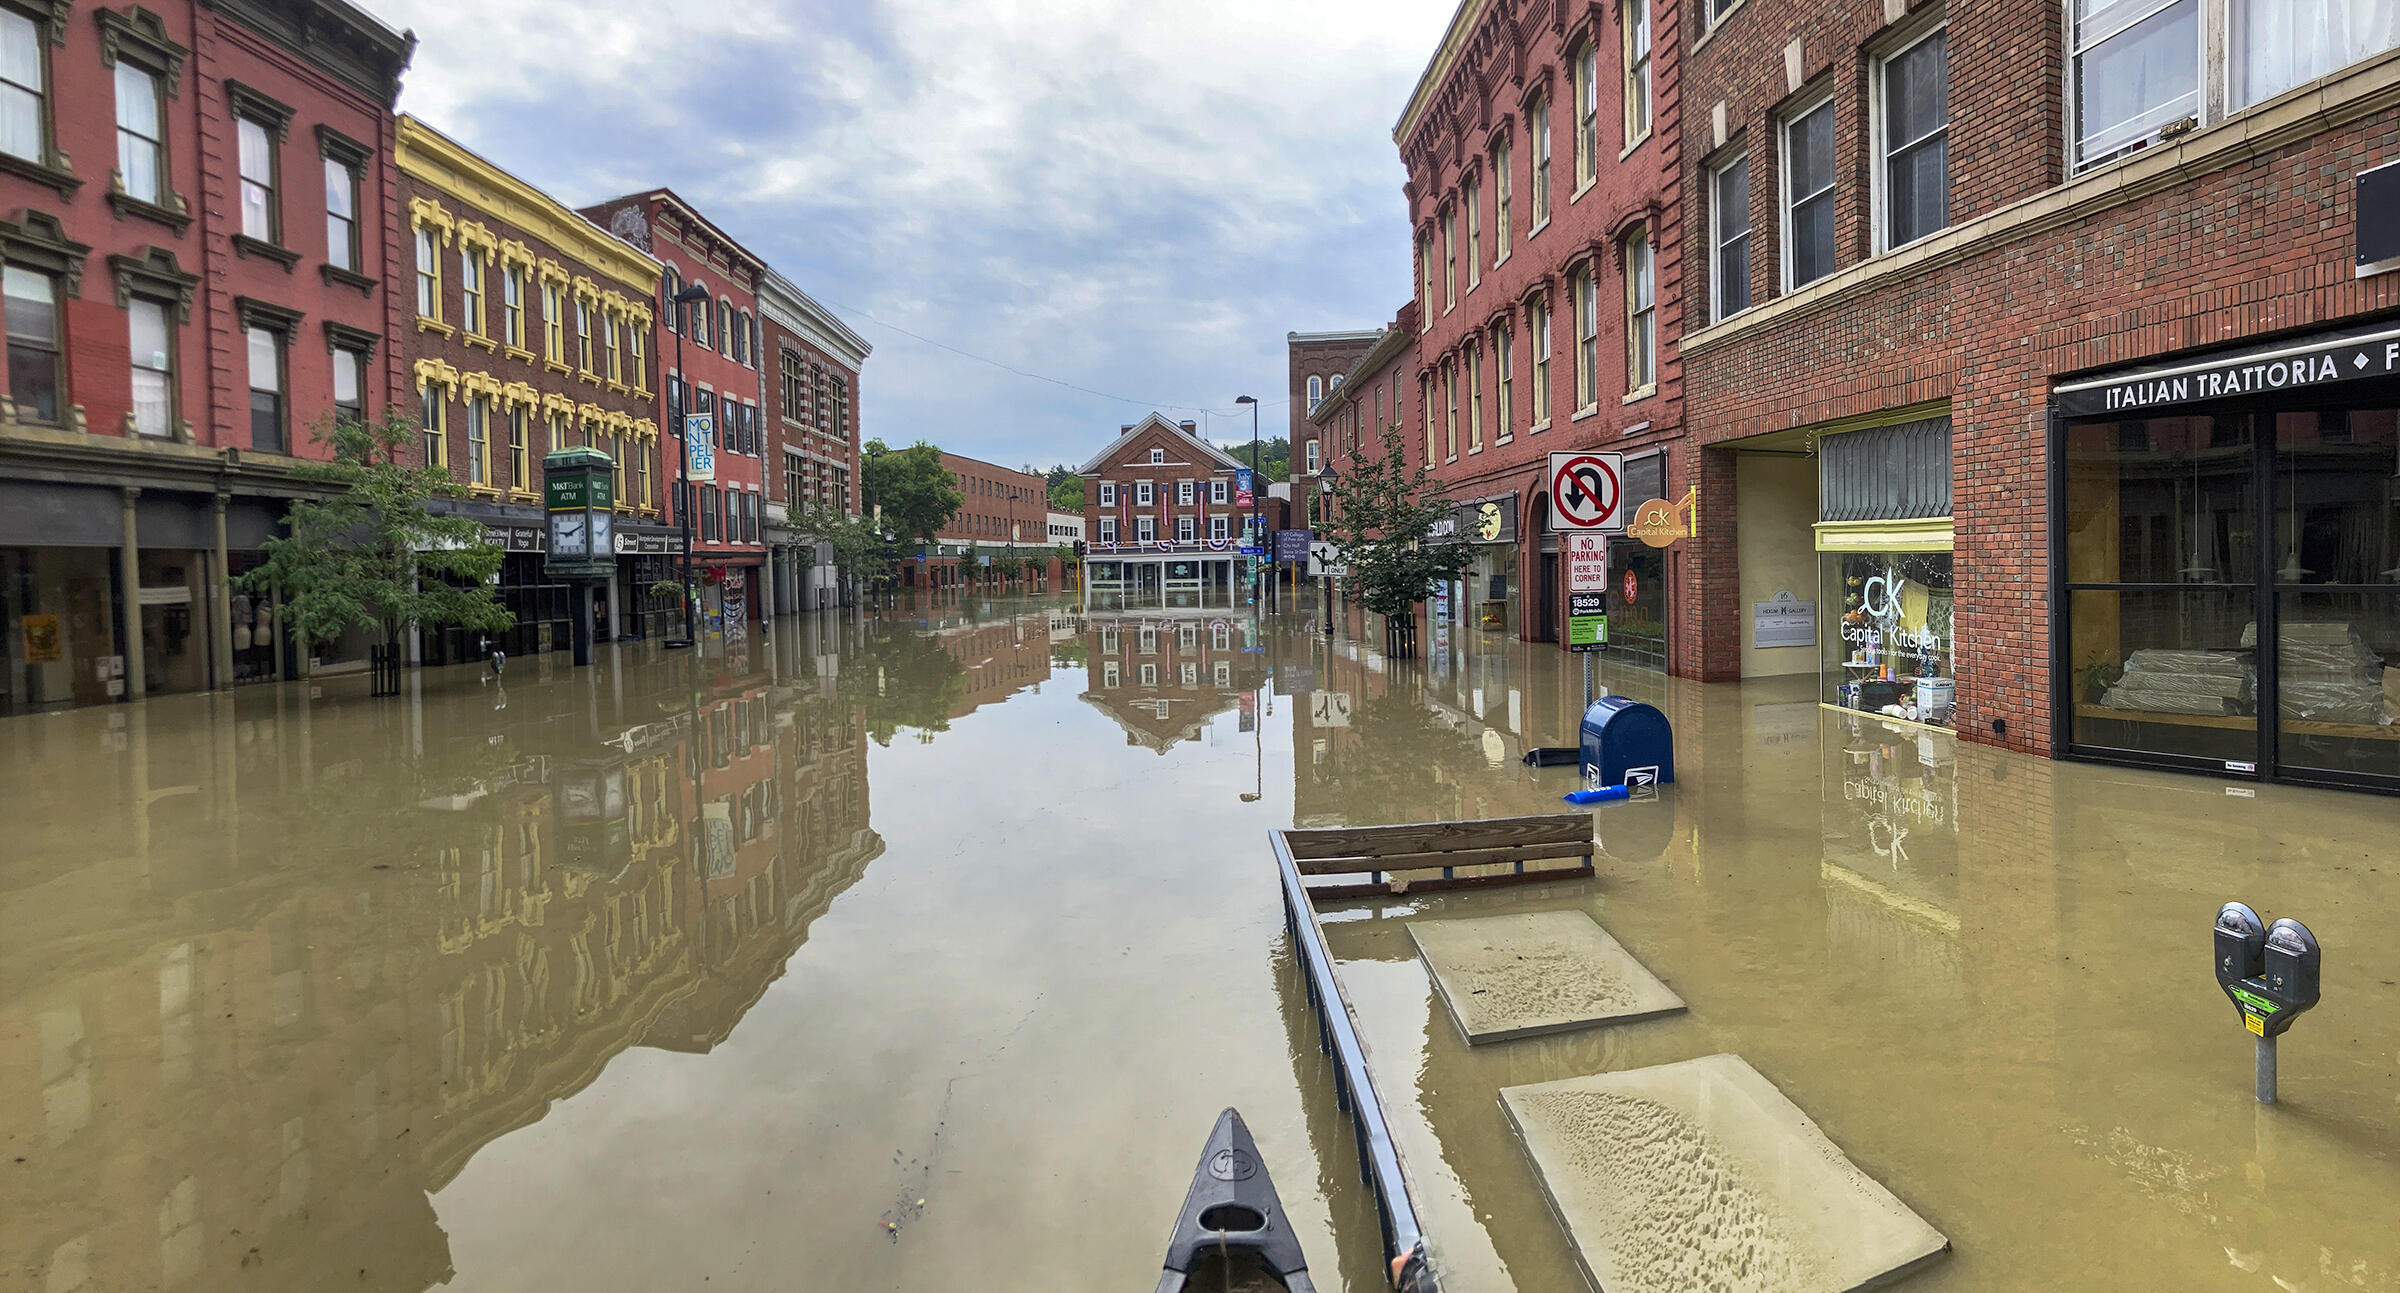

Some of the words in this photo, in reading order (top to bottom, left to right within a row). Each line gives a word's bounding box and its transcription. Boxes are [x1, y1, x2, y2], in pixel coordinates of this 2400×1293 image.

[2105, 377, 2188, 410] ITALIAN
[2196, 354, 2339, 397] TRATTORIA
[560, 492, 577, 501] ATM
[1630, 527, 1658, 537] Capital
[1659, 527, 1687, 536] Kitchen
[1580, 539, 1594, 551] NO
[1571, 550, 1604, 562] PARKING
[1574, 565, 1591, 573] HERE
[1593, 564, 1602, 573] TO
[1574, 574, 1601, 583] CORNER
[1780, 591, 1788, 600] 16
[1572, 598, 1600, 607] 18529
[1840, 620, 1883, 646] Capital
[1889, 625, 1941, 650] Kitchen
[1875, 647, 1888, 656] tools
[1897, 650, 1906, 658] the
